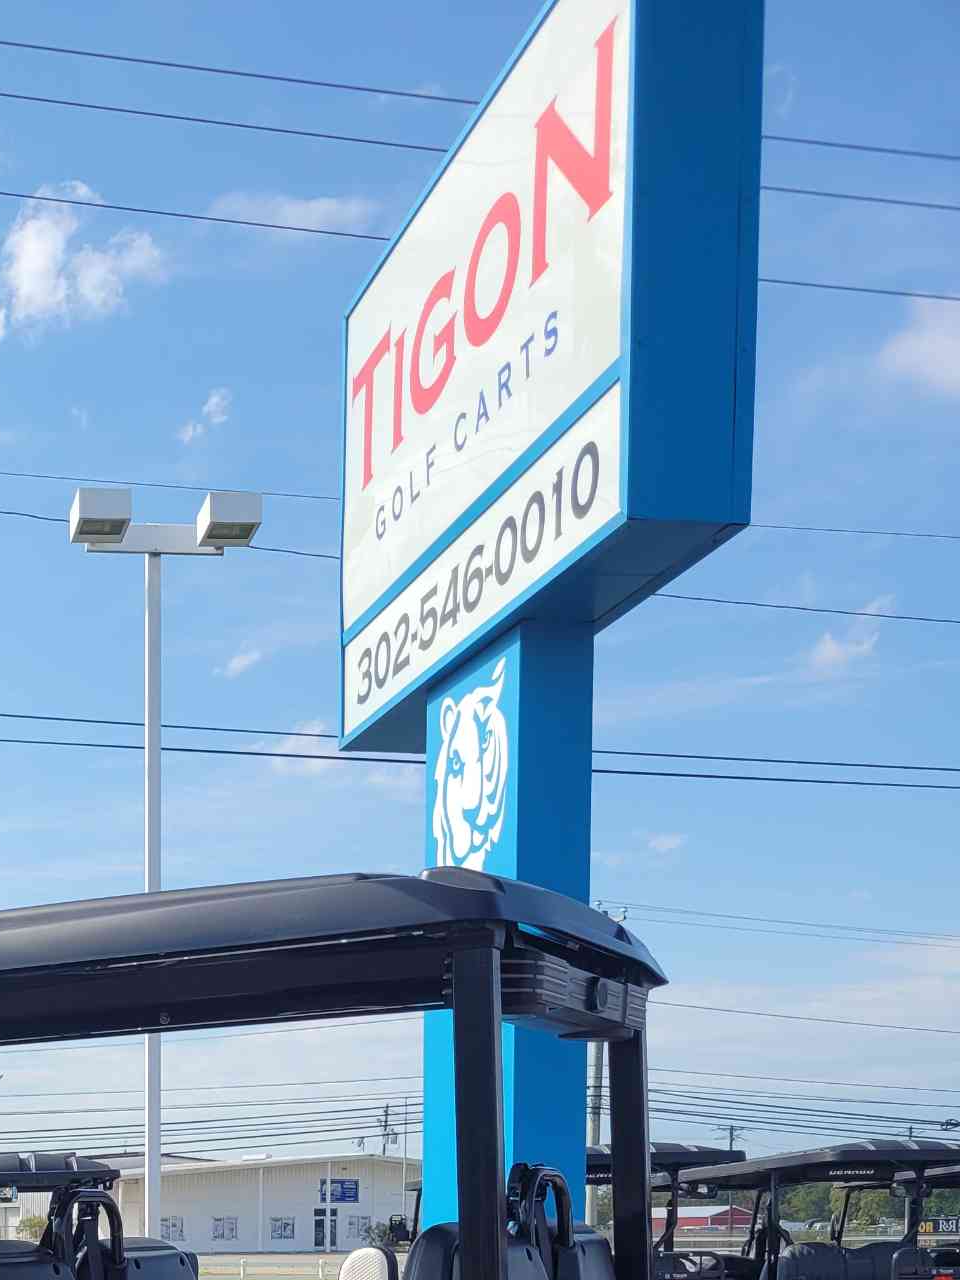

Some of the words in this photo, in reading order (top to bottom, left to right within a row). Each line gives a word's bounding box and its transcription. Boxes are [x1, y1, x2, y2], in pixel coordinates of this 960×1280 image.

[351, 15, 619, 491] TIGON
[375, 443, 436, 541] GOLF
[453, 310, 559, 453] CARTS
[356, 440, 600, 705] 302-546-0010
